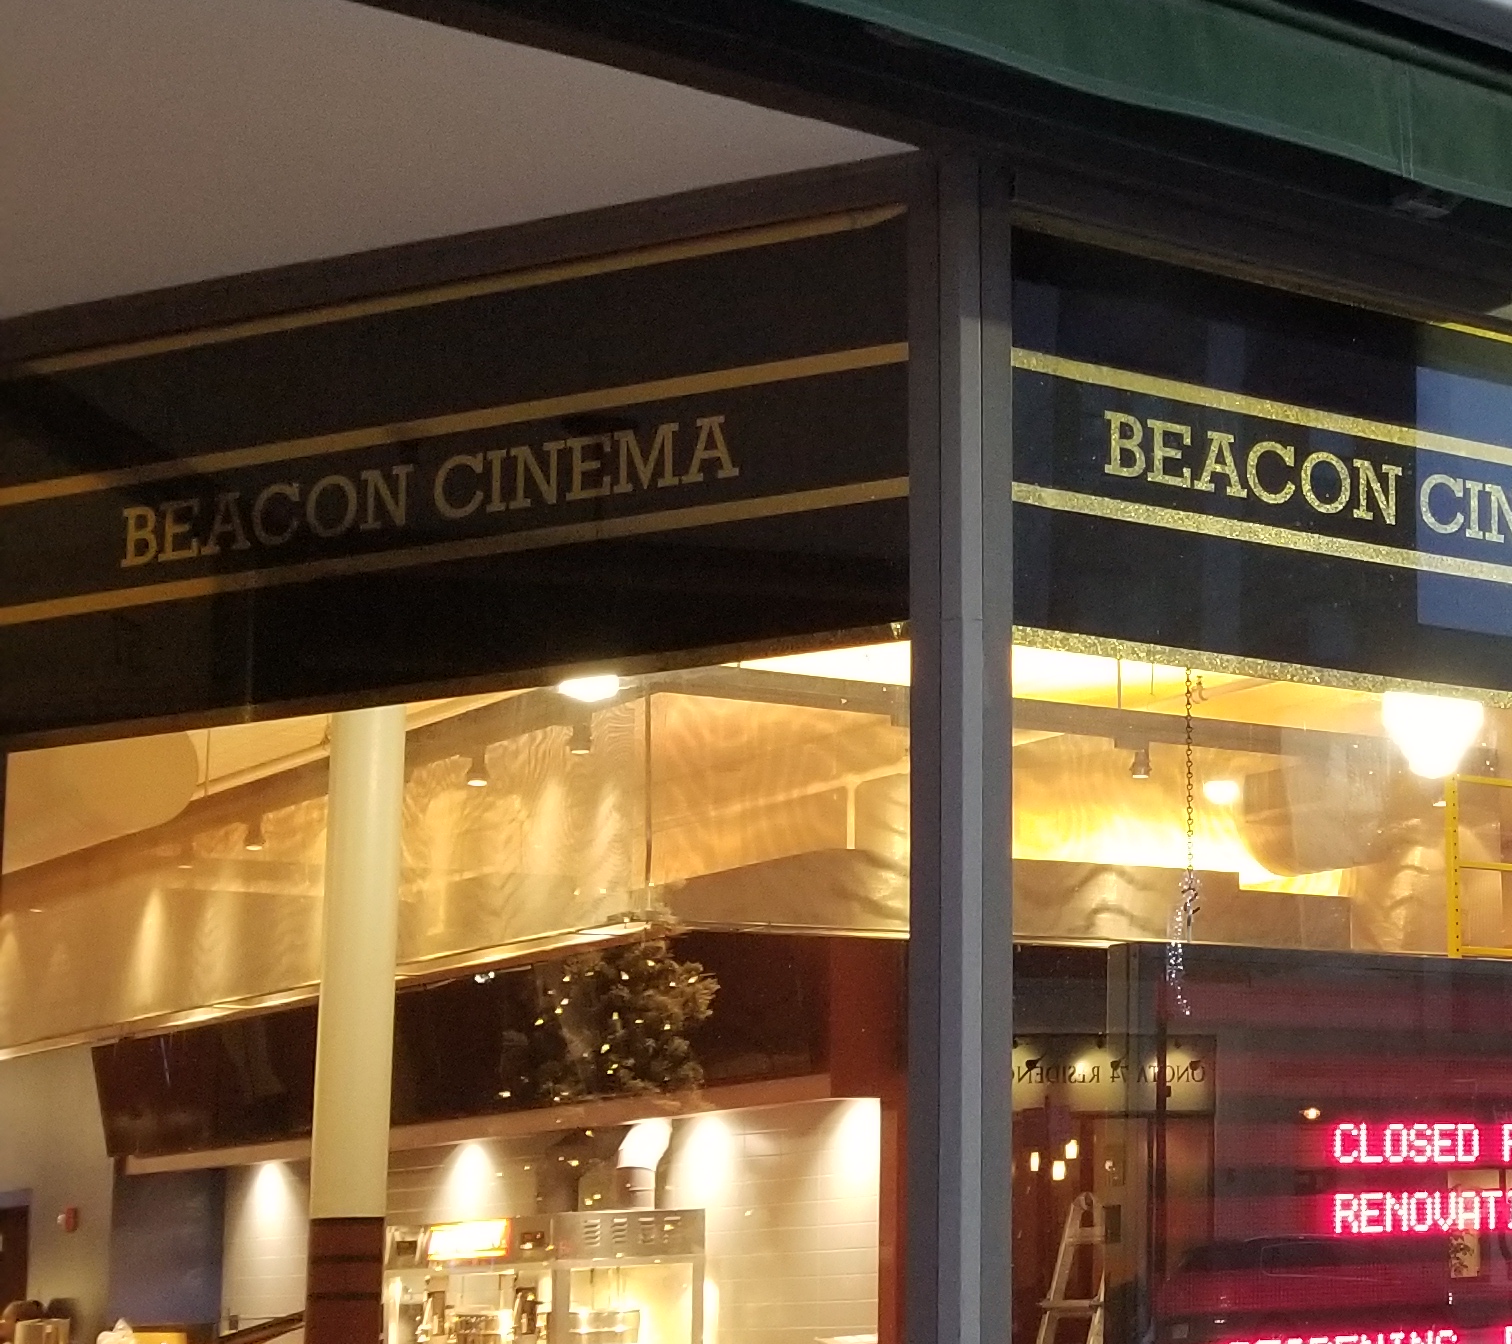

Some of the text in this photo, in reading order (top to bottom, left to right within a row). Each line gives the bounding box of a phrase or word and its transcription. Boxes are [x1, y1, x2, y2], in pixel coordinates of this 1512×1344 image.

[120, 415, 739, 568] BEACON CINEMA
[1104, 410, 1402, 526] BEACON
[1333, 1123, 1480, 1164] CLOSED
